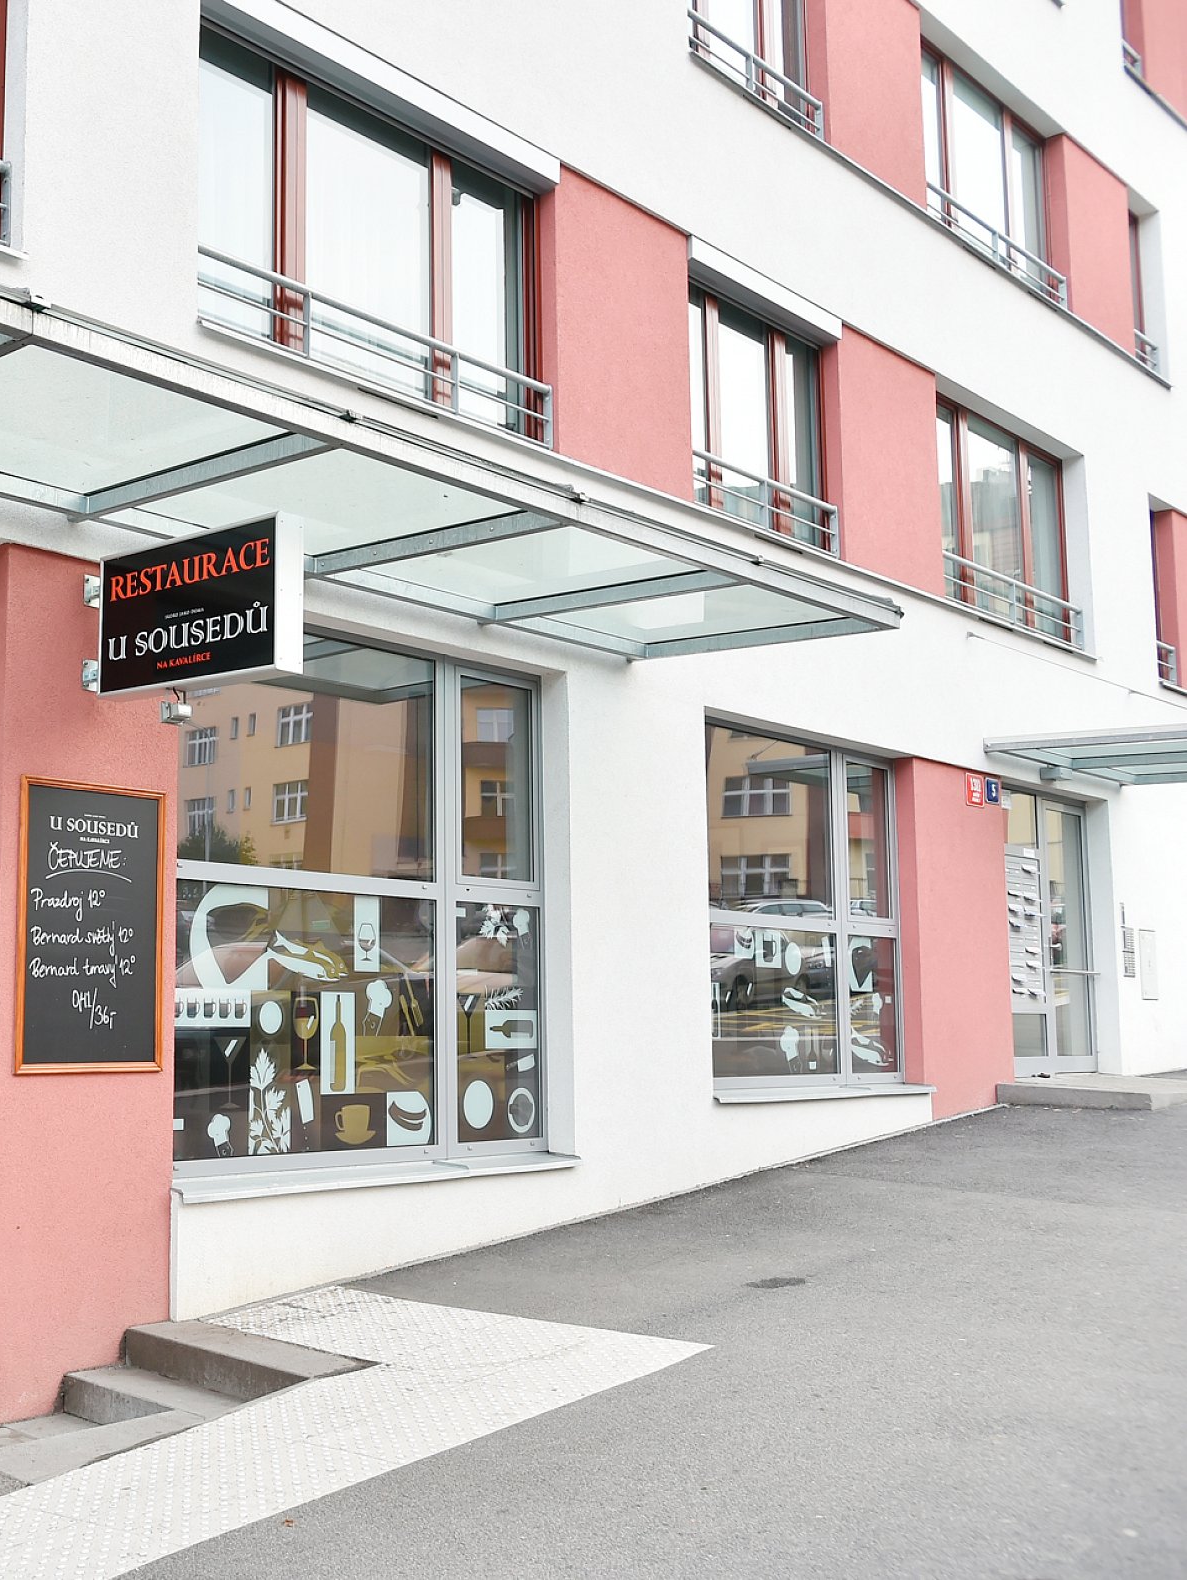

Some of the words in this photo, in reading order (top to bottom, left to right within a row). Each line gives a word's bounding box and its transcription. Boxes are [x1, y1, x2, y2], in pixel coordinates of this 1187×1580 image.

[110, 538, 270, 602] RESTAURACE
[108, 635, 127, 660] U
[135, 601, 269, 656] SOUSEDŮ
[157, 661, 167, 669] NA
[169, 652, 211, 667] KAVALÍRCE
[991, 783, 997, 797] 5
[49, 816, 63, 830] U
[66, 817, 139, 838] SOUSEDŮ
[30, 888, 84, 921] Prazdroj
[30, 925, 84, 945] Bernard
[29, 957, 80, 978] Bernard
